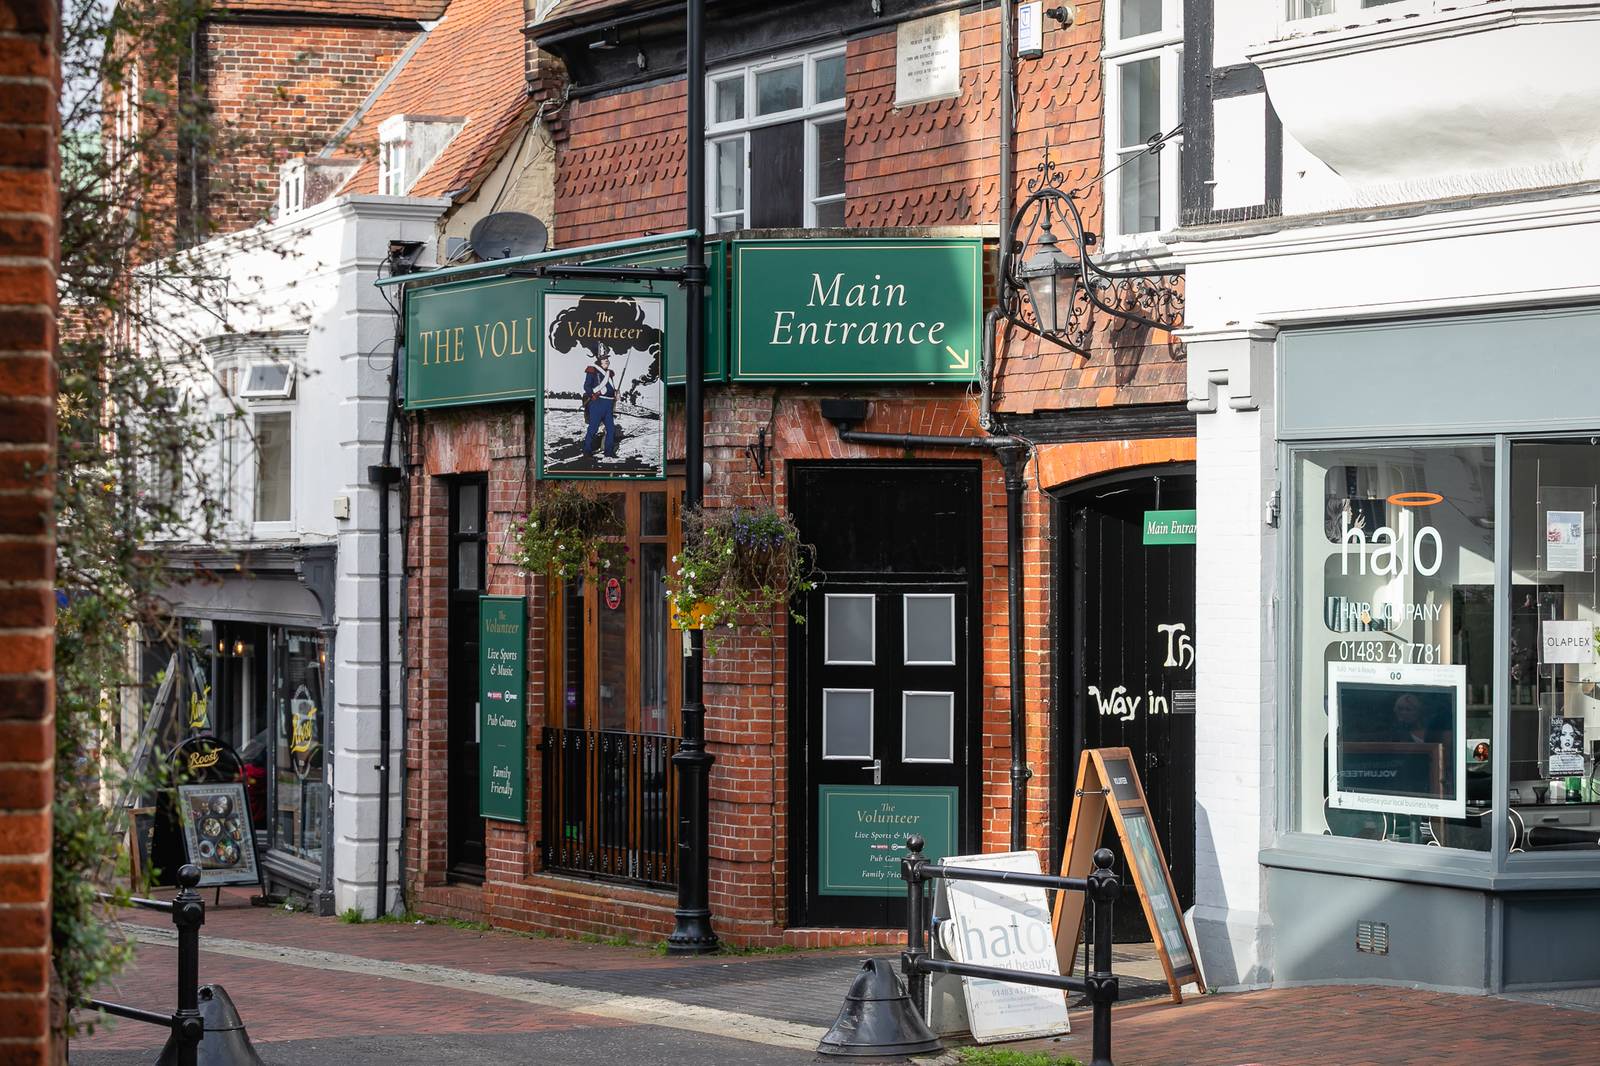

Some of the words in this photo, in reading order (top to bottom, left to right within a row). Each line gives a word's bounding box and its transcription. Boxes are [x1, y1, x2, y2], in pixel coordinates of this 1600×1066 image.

[807, 272, 907, 308] Main
[596, 312, 614, 323] The
[567, 320, 643, 339] Volunteer
[769, 309, 945, 345] Entrance
[420, 327, 465, 366] THE
[1147, 521, 1168, 535] Main
[1341, 509, 1443, 577] halo
[498, 610, 508, 620] The
[485, 618, 519, 634] Volunteer
[1547, 637, 1590, 647] OLAPLEX
[487, 647, 501, 660] Live
[501, 648, 517, 664] Sports
[1339, 640, 1384, 661] 01483
[490, 663, 497, 675] &
[497, 664, 513, 676] Music
[1088, 685, 1141, 722] Way
[1148, 690, 1169, 715] in
[487, 714, 499, 727] Pub
[499, 715, 517, 728] Games
[188, 747, 224, 769] Roost
[492, 765, 512, 780] Family
[490, 781, 513, 799] Friendly
[881, 803, 896, 812] The
[857, 810, 920, 824] Volunteer
[854, 831, 869, 839] Live
[871, 831, 892, 840] Sports
[893, 831, 901, 839] &
[862, 870, 885, 880] Family
[961, 914, 1048, 961] halo
